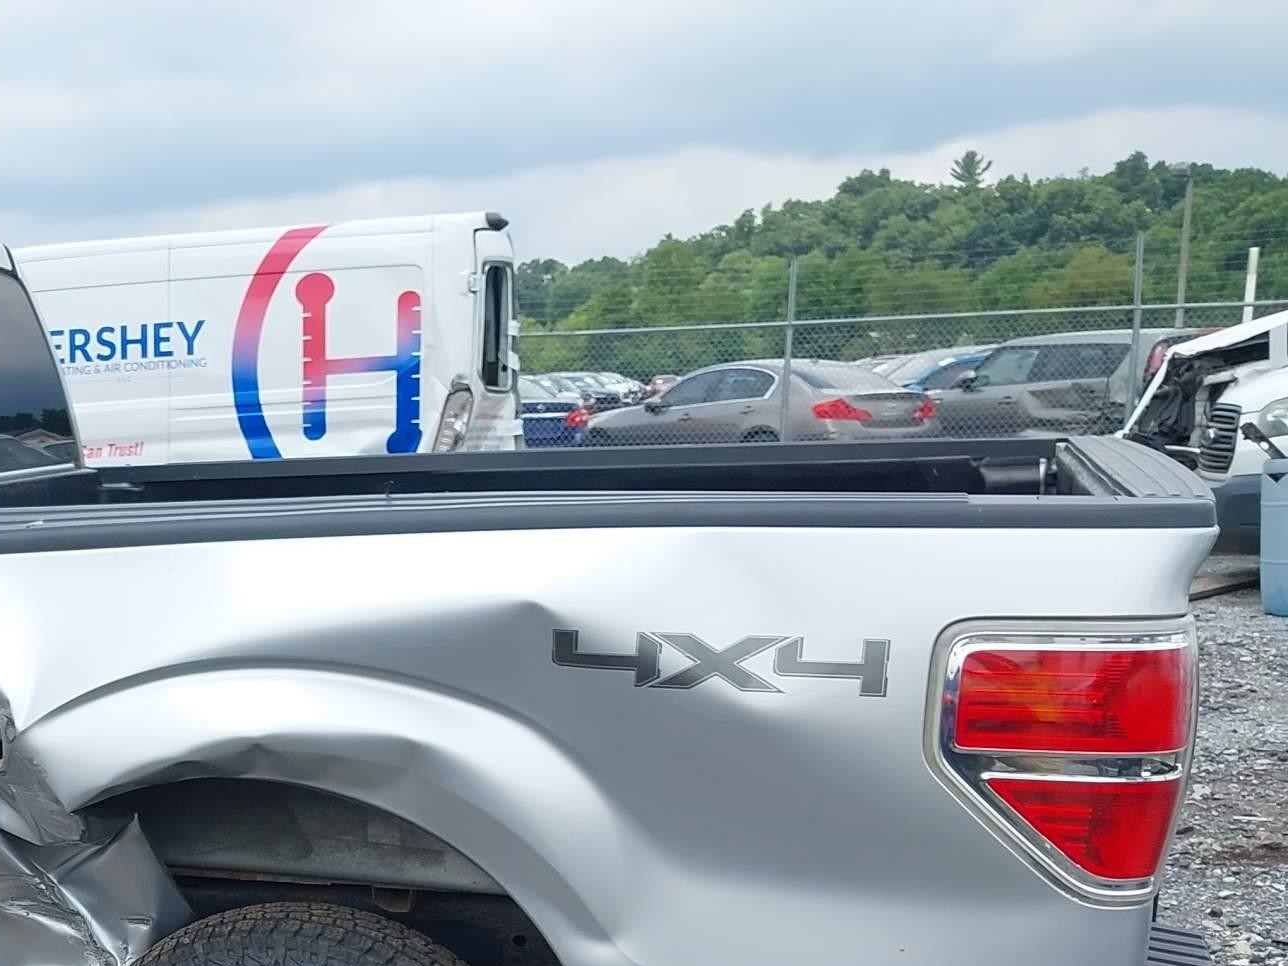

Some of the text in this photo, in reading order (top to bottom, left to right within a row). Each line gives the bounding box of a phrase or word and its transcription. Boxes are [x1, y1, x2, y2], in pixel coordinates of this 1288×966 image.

[94, 363, 102, 374] &
[103, 361, 122, 373] AIR
[123, 357, 208, 373] CONDITIONING
[107, 441, 145, 457] Trust!
